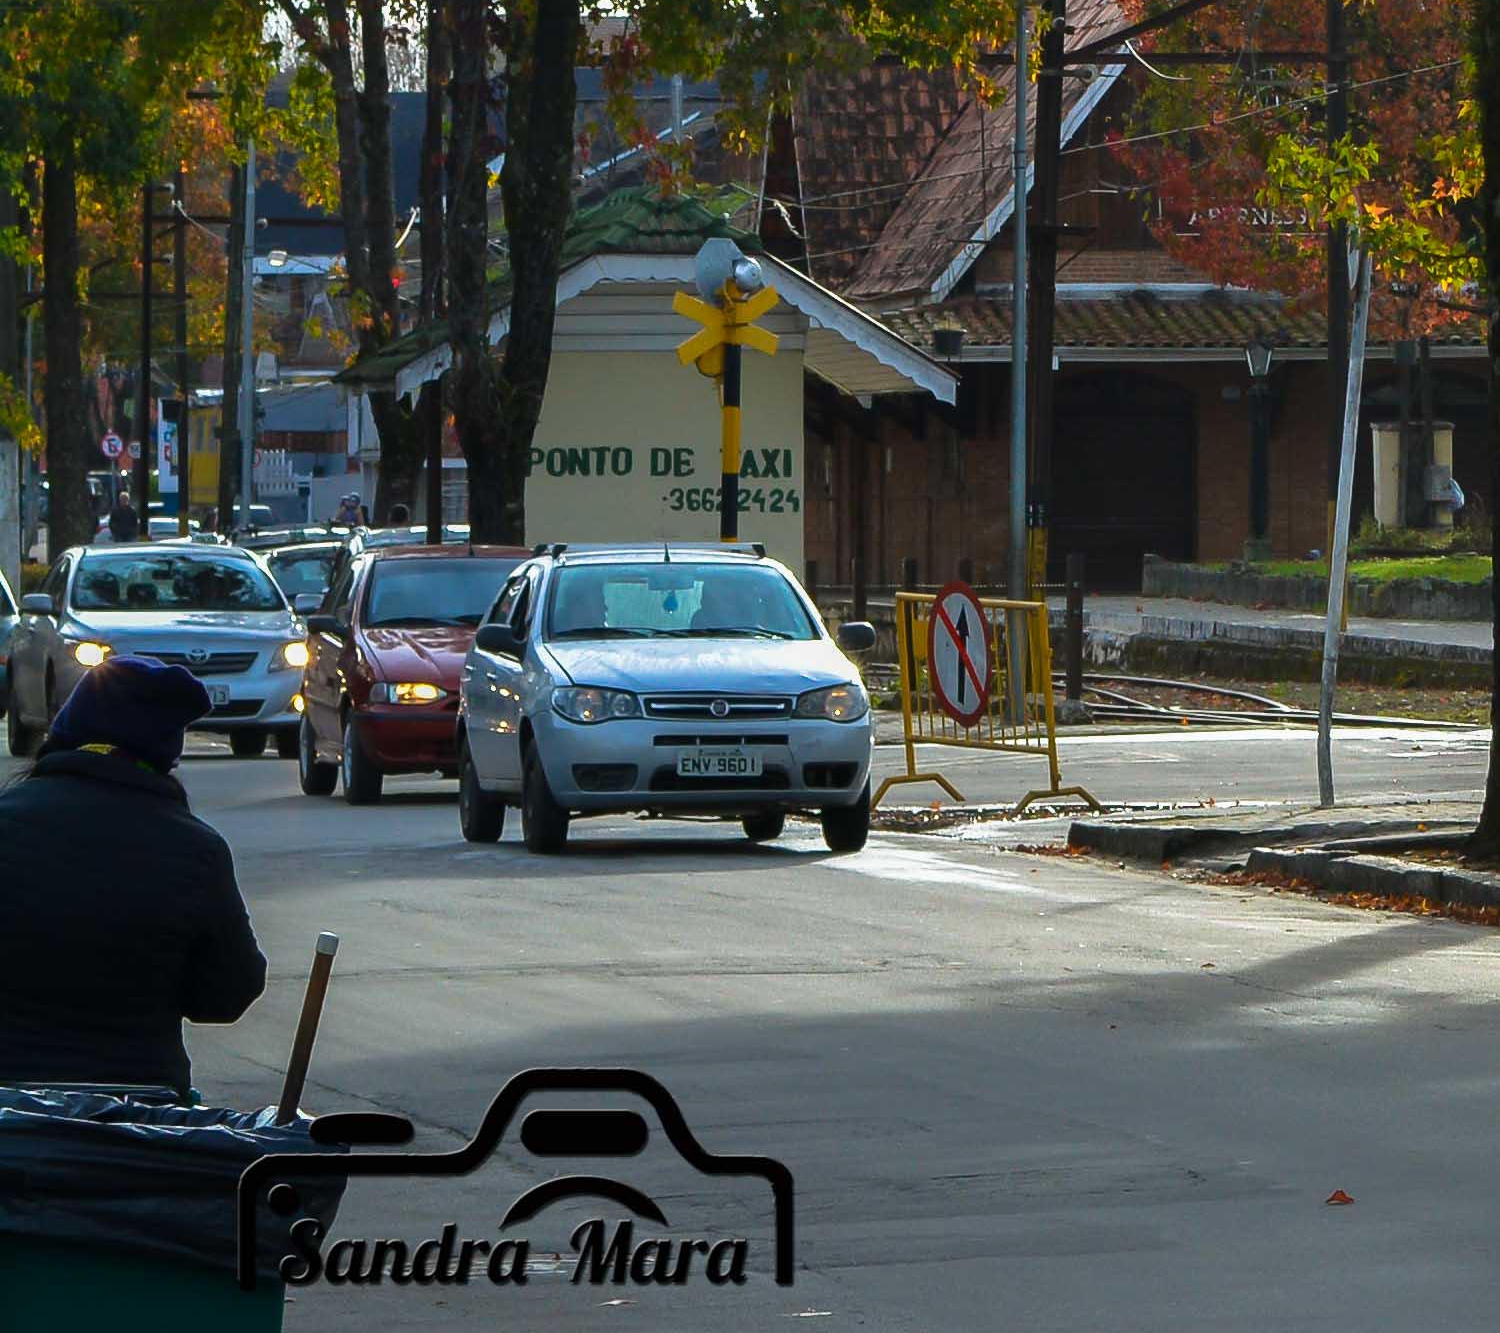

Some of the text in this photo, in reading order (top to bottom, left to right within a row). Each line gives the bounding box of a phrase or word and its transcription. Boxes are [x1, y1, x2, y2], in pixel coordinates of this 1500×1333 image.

[527, 445, 792, 478] PONTO DE AXI
